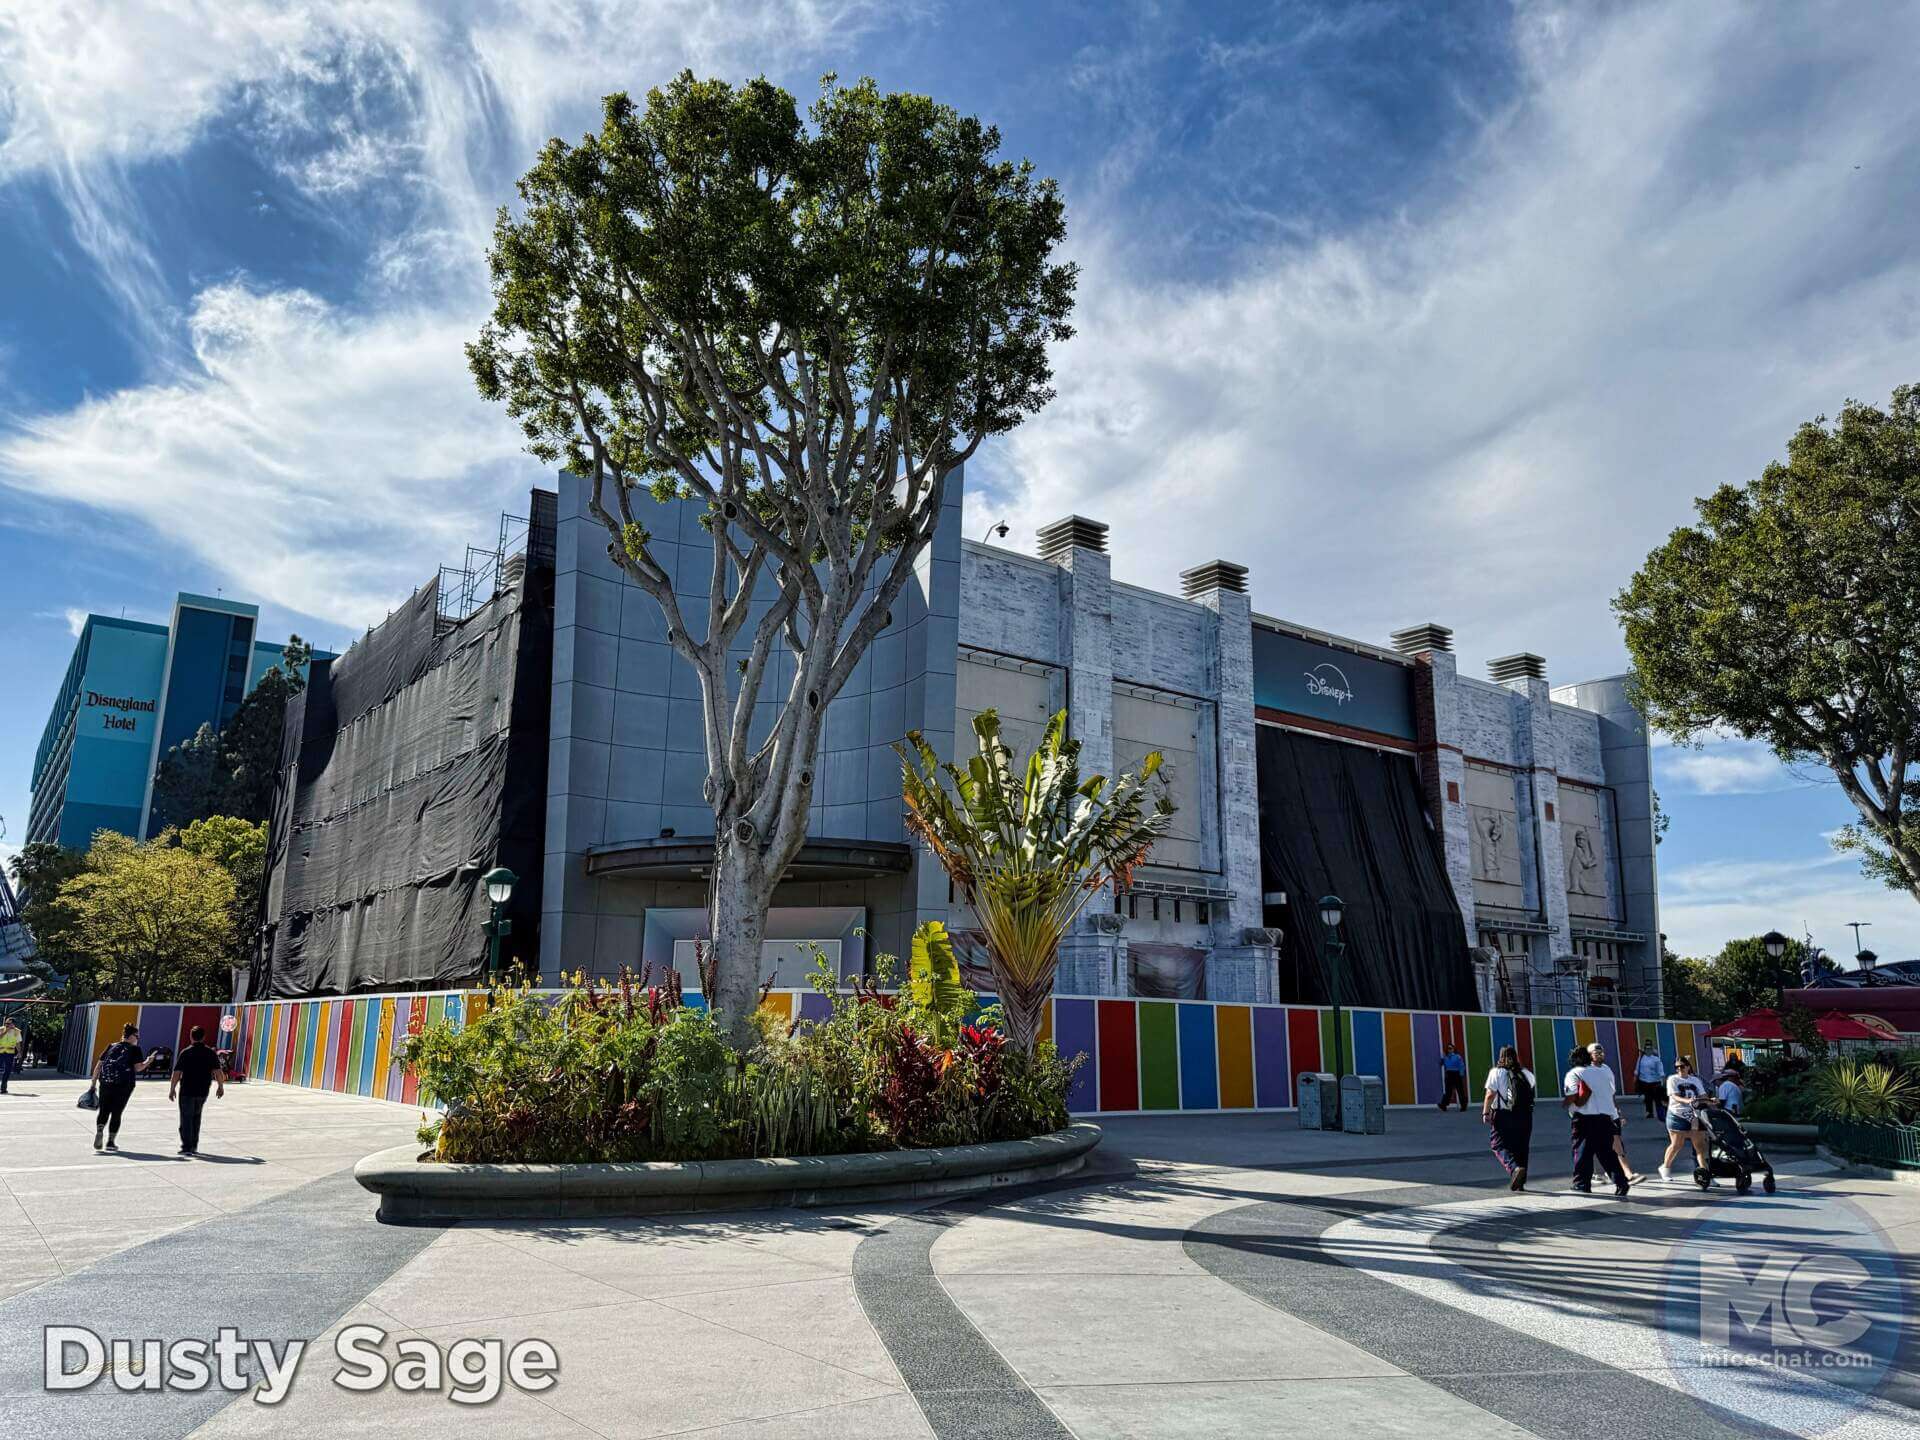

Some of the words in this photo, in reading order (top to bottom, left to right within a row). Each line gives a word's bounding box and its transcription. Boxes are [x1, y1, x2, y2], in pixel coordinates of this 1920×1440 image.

[1304, 671, 1354, 706] Disney+
[85, 691, 155, 712] Disneyland
[103, 713, 136, 731] Hotel
